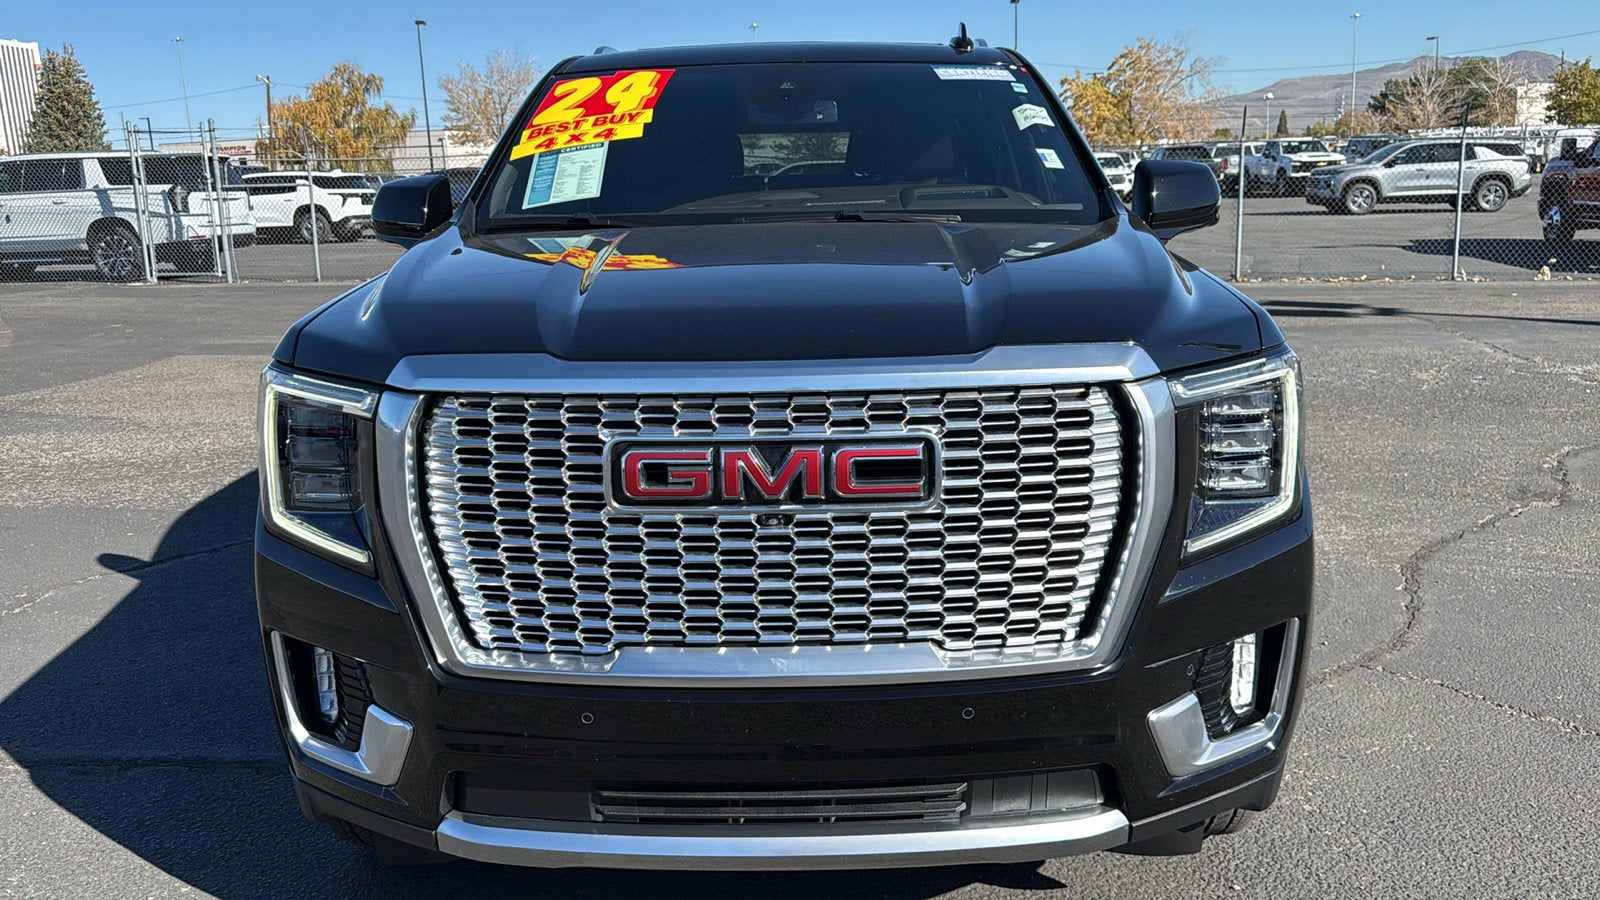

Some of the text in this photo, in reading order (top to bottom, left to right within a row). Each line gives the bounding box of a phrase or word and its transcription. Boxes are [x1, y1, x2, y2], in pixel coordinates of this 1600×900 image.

[939, 68, 1008, 77] CERTIFIED
[532, 71, 662, 125] 24
[527, 111, 646, 141] BEST BUY
[534, 136, 558, 150] 4
[593, 127, 618, 140] 4
[561, 143, 602, 153] CERTIFIED
[621, 445, 925, 500] GMC
